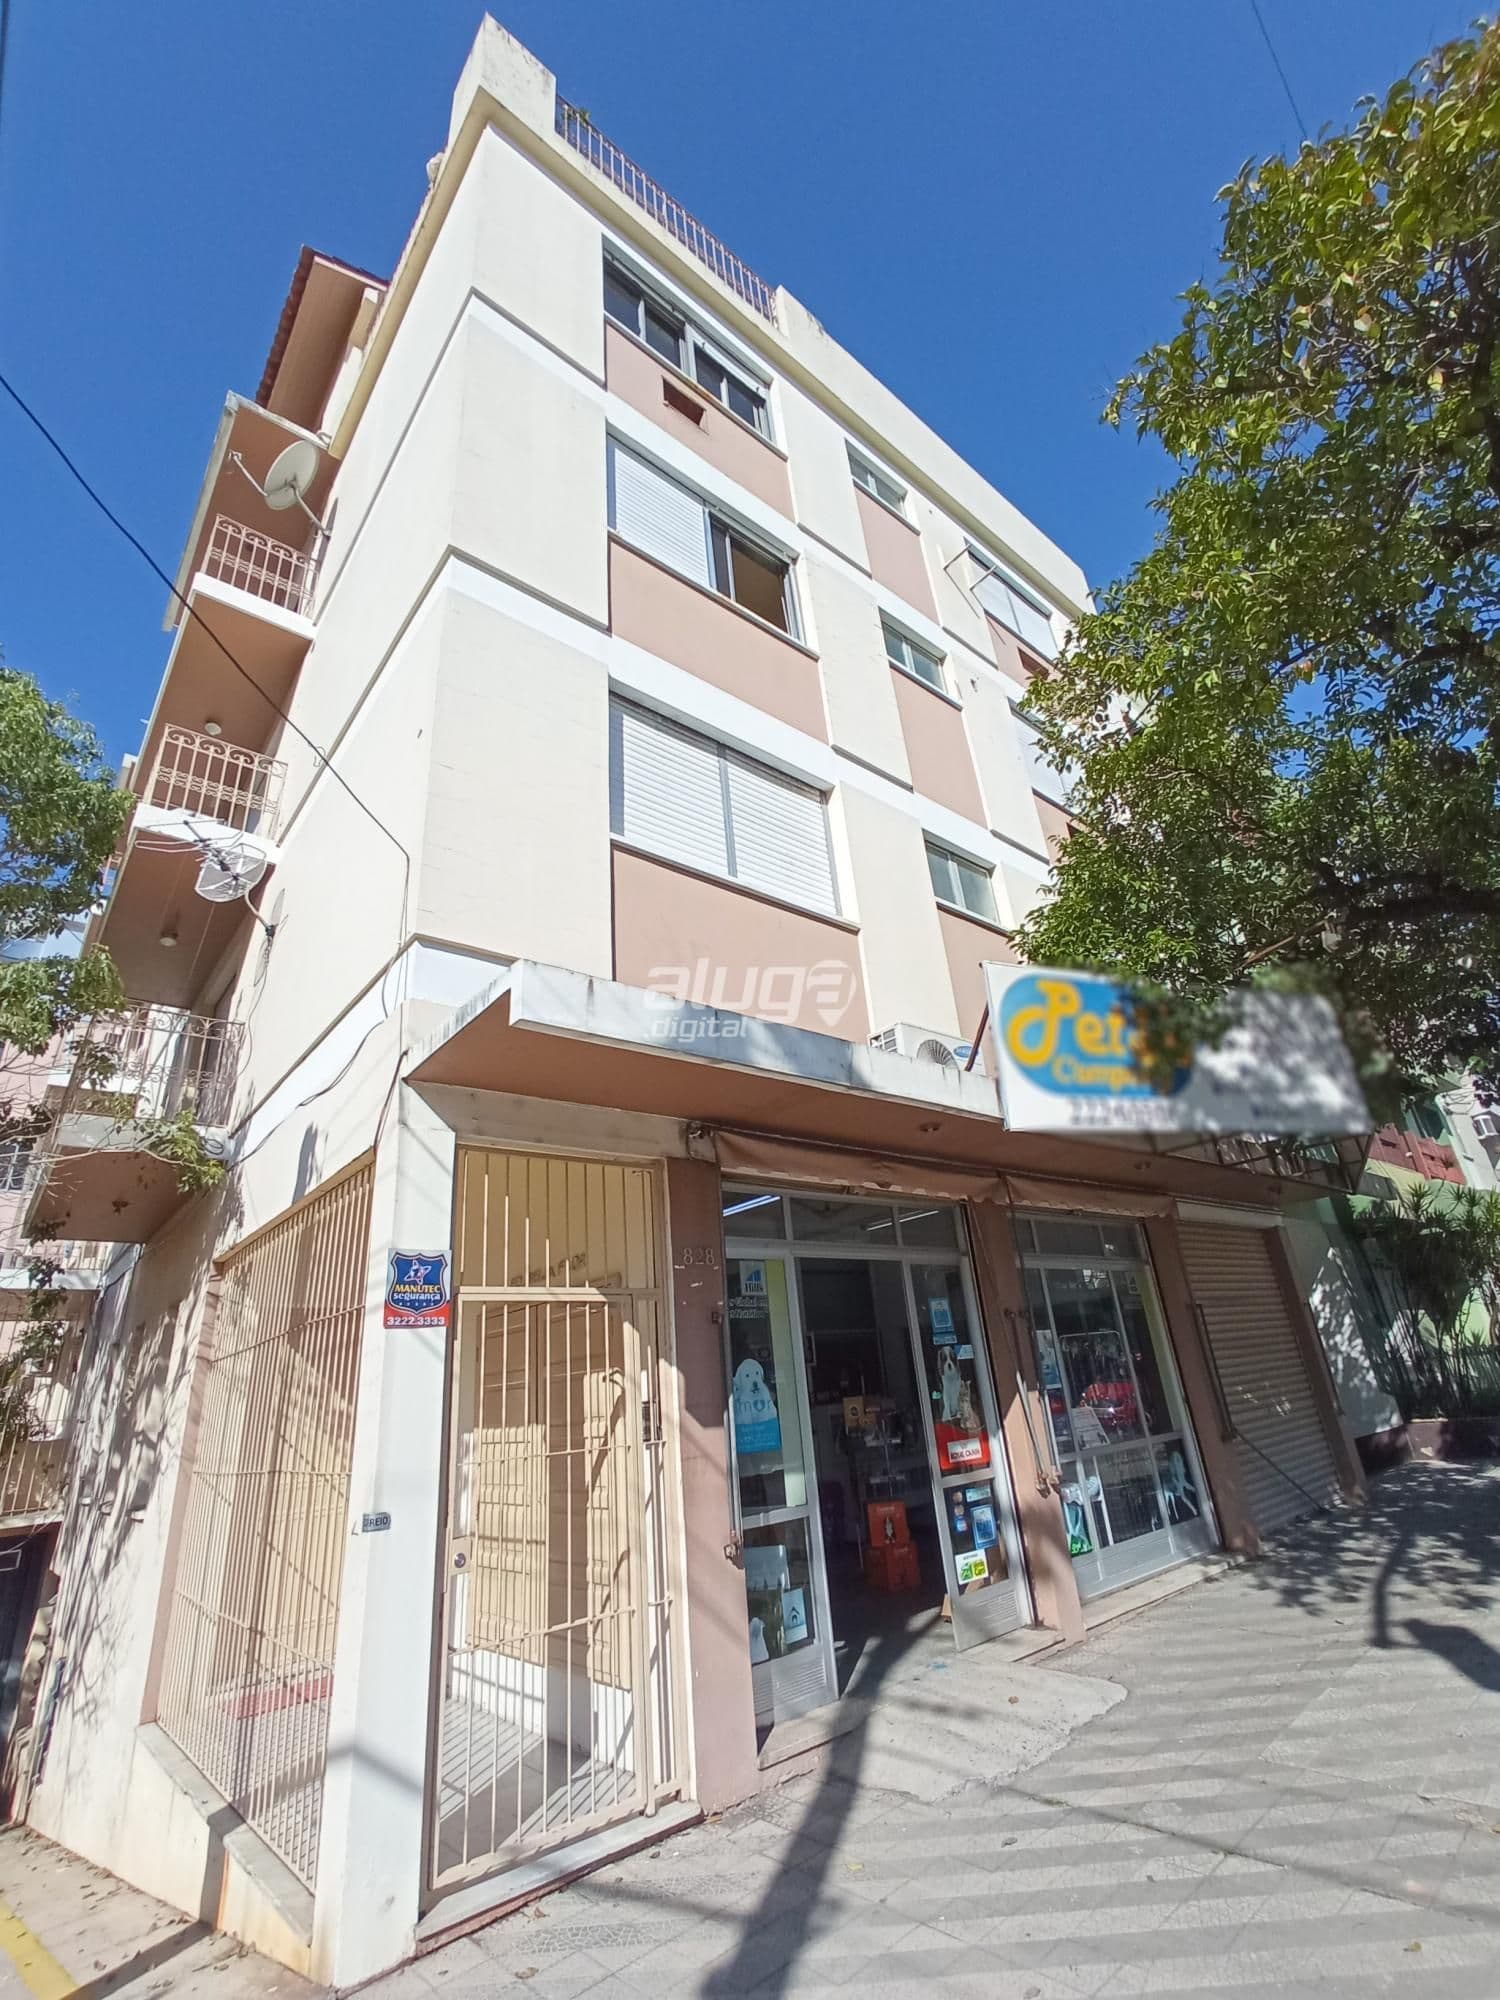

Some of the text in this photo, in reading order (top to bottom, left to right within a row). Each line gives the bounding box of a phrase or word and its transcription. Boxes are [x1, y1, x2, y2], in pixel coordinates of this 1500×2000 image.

[683, 1247, 715, 1265] 828
[395, 1284, 440, 1292] MANUTEC
[393, 1292, 441, 1301] segurança
[387, 1316, 445, 1326] 3222.3333
